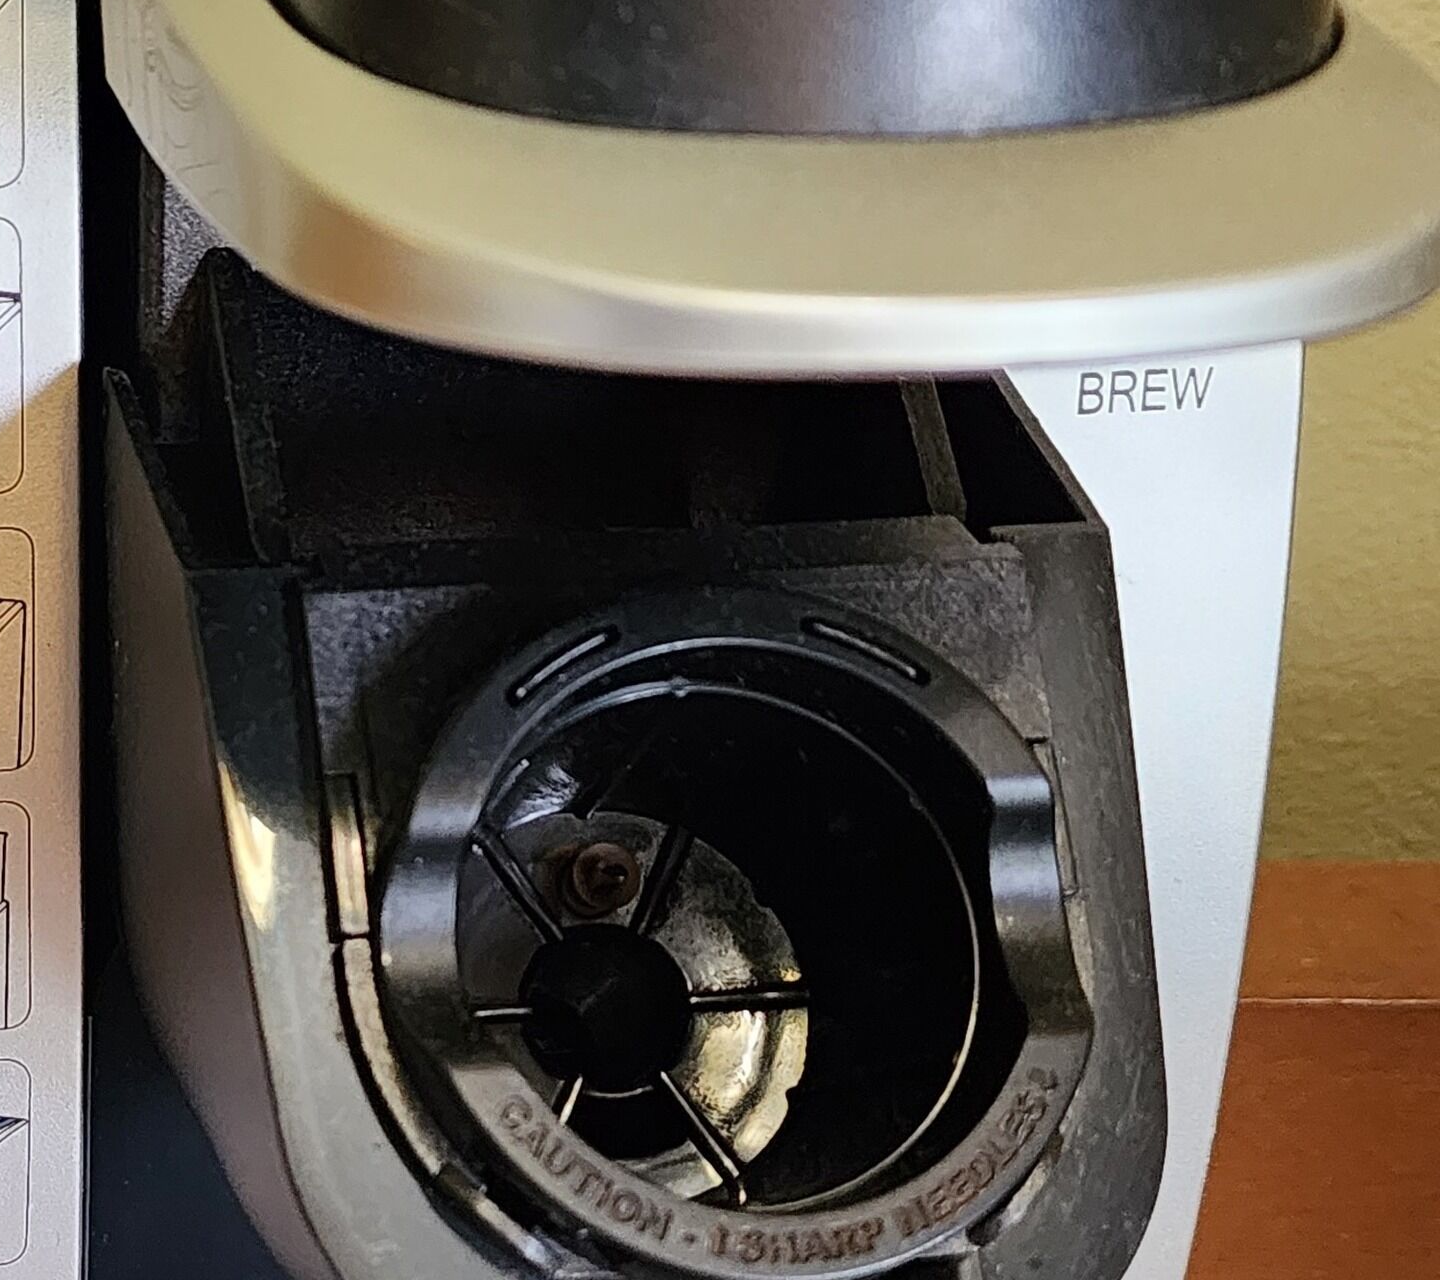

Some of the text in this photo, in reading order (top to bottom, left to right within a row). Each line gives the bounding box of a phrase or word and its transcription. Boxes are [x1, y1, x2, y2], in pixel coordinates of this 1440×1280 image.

[1076, 366, 1214, 415] BREW
[500, 1094, 673, 1240] CAUTION
[739, 1216, 884, 1265] SHARP
